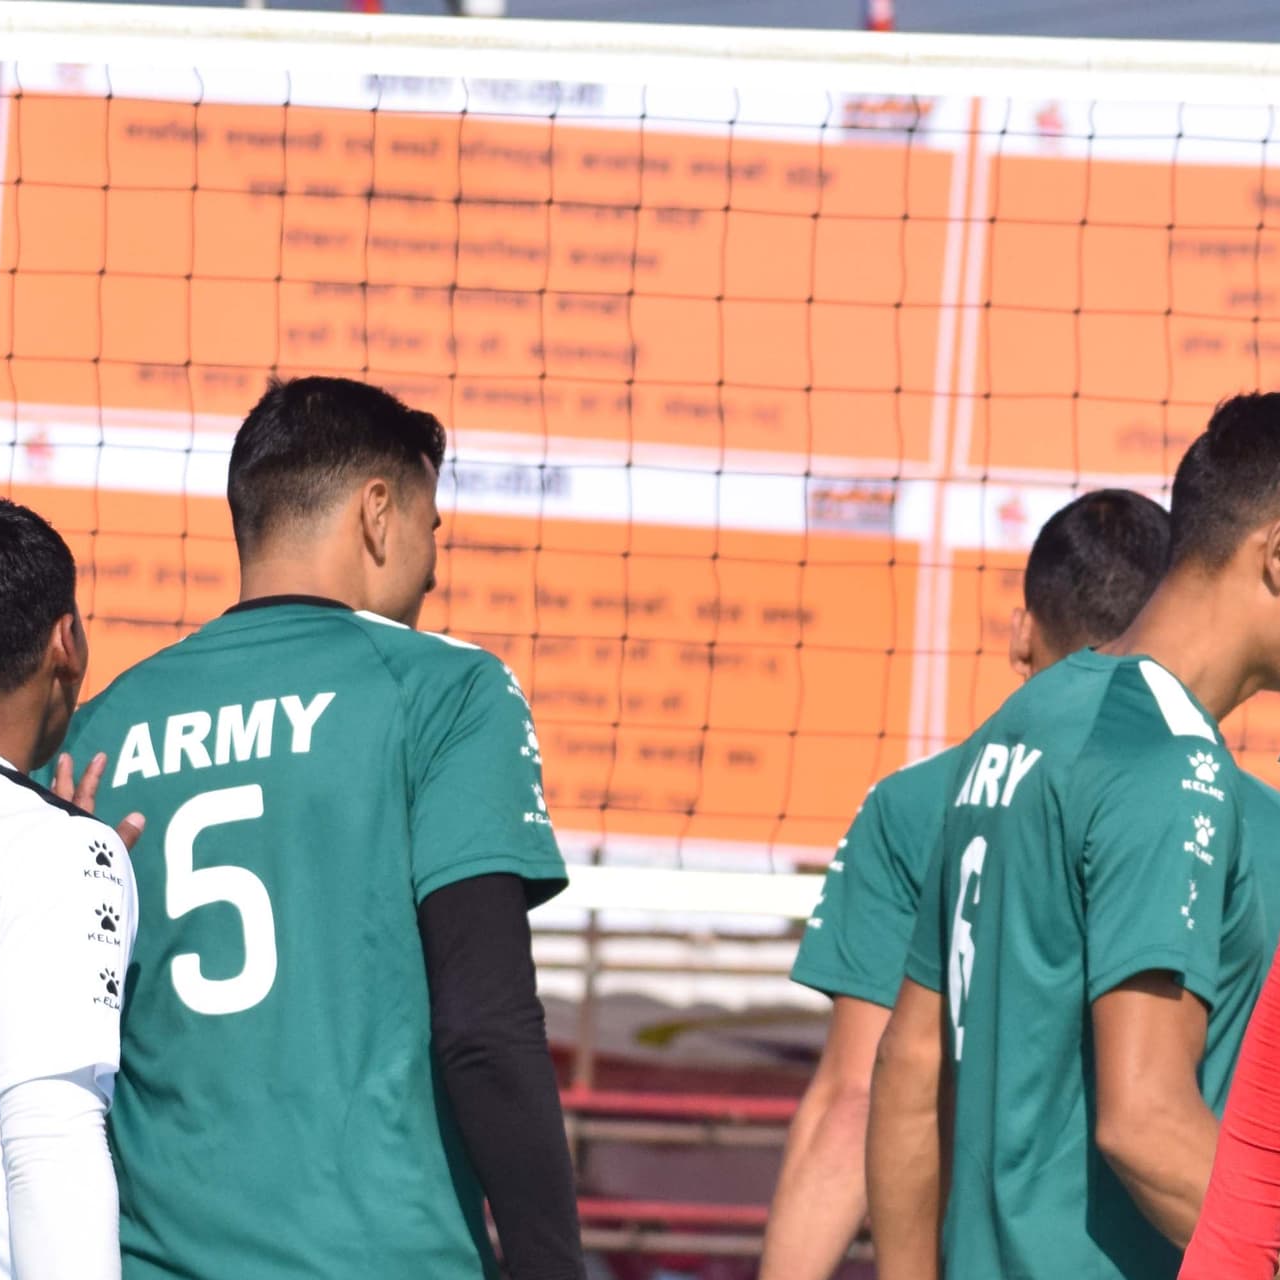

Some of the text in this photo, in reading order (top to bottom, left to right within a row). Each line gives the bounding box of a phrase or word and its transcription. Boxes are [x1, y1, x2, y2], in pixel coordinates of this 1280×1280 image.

[111, 692, 336, 788] ARMY
[1181, 770, 1224, 801] KELME
[164, 783, 278, 1015] 5
[87, 932, 121, 947] KELM
